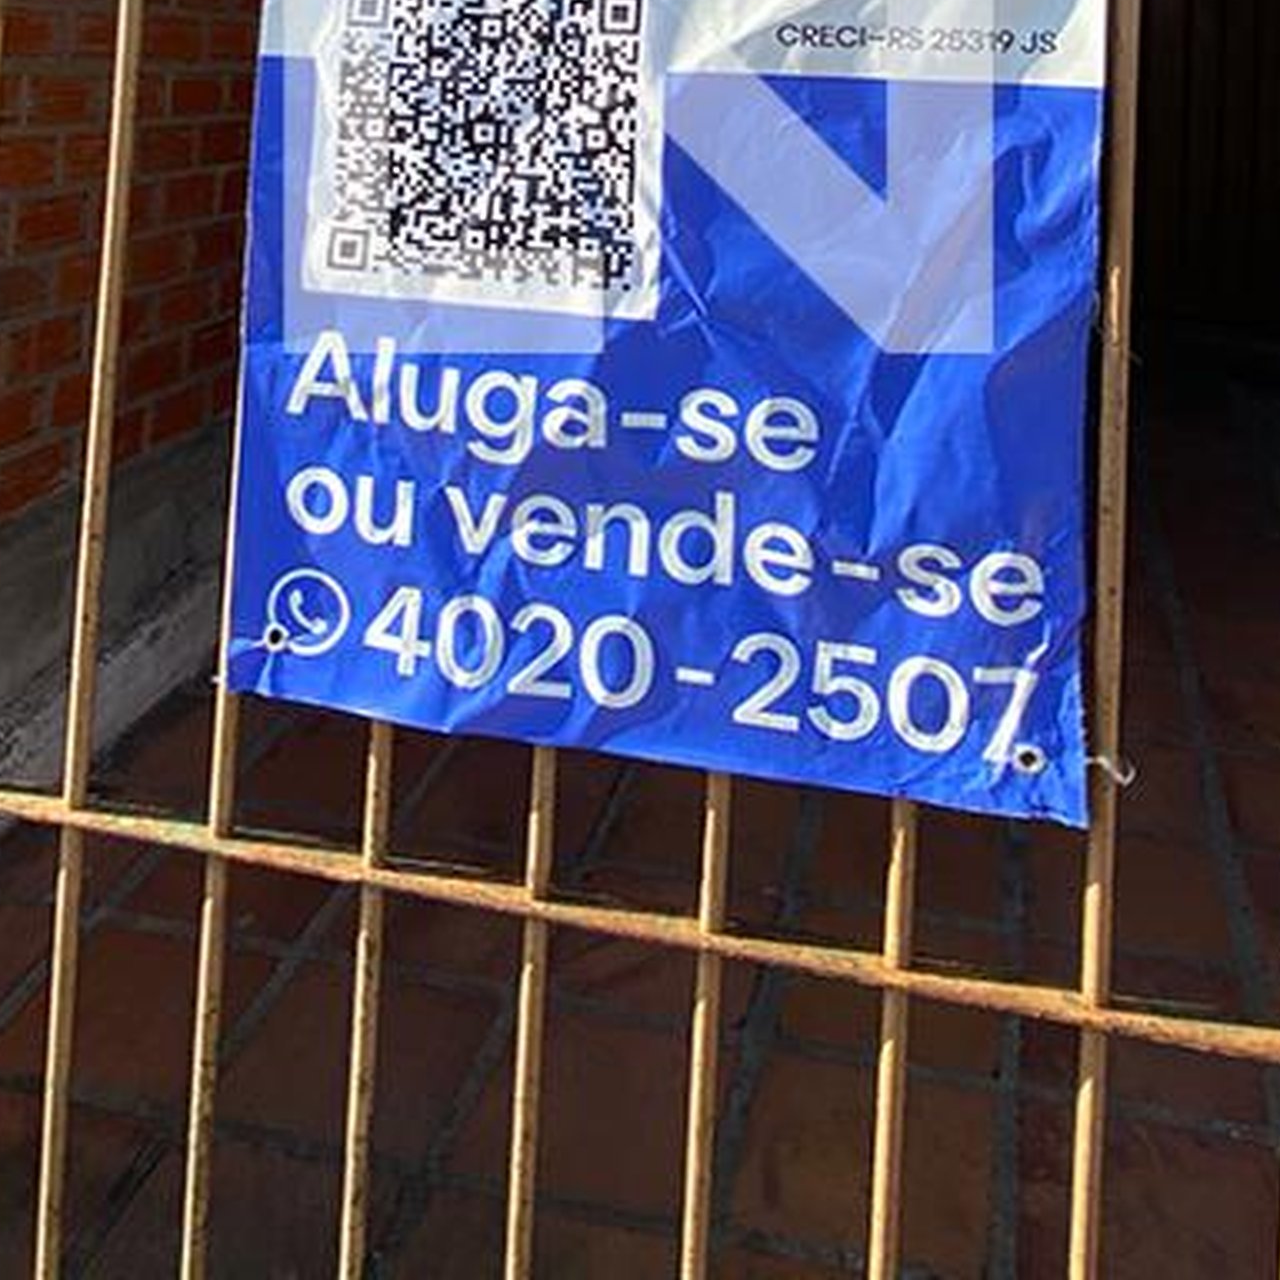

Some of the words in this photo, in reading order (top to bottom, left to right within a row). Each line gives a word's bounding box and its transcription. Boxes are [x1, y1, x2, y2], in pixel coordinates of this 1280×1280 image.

[775, 22, 924, 52] CRECI-RS
[930, 26, 1015, 54] 25319
[1019, 30, 1058, 55] JS
[285, 329, 821, 472] Aluga-se
[285, 464, 416, 548] ou
[445, 492, 1046, 626] vende-se
[362, 585, 1041, 763] 4020-2507
